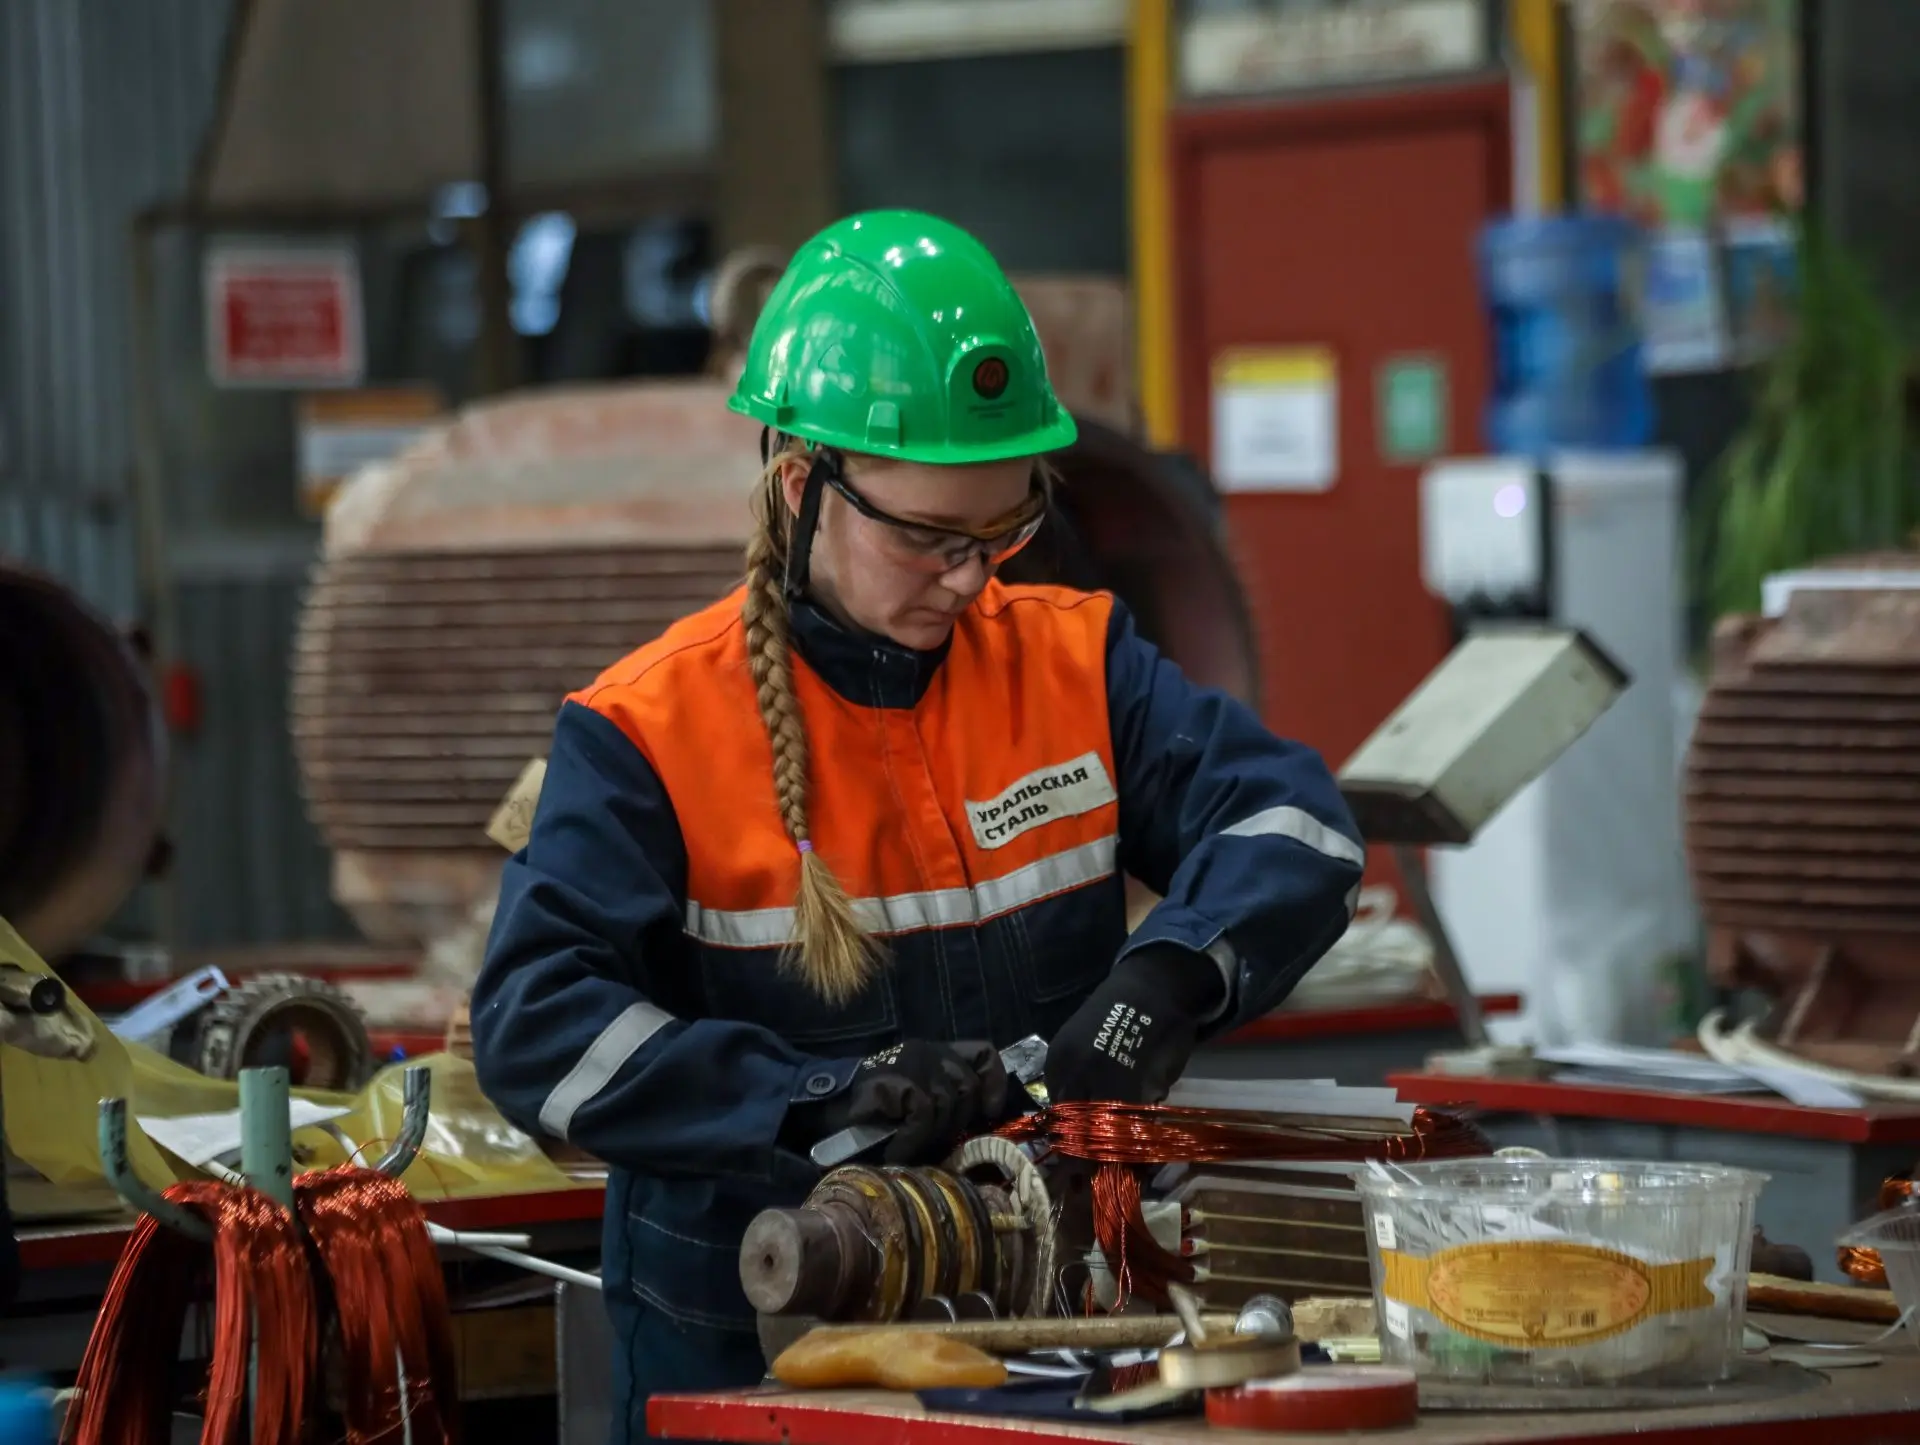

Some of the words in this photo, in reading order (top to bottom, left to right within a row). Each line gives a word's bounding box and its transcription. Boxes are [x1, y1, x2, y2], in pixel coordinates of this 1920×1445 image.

[976, 767, 1089, 823] УРАЛЬСКАЯ
[984, 803, 1049, 840] СТАЛЬ
[1093, 1003, 1127, 1051] ПАЛМА
[1139, 1014, 1152, 1026] 8
